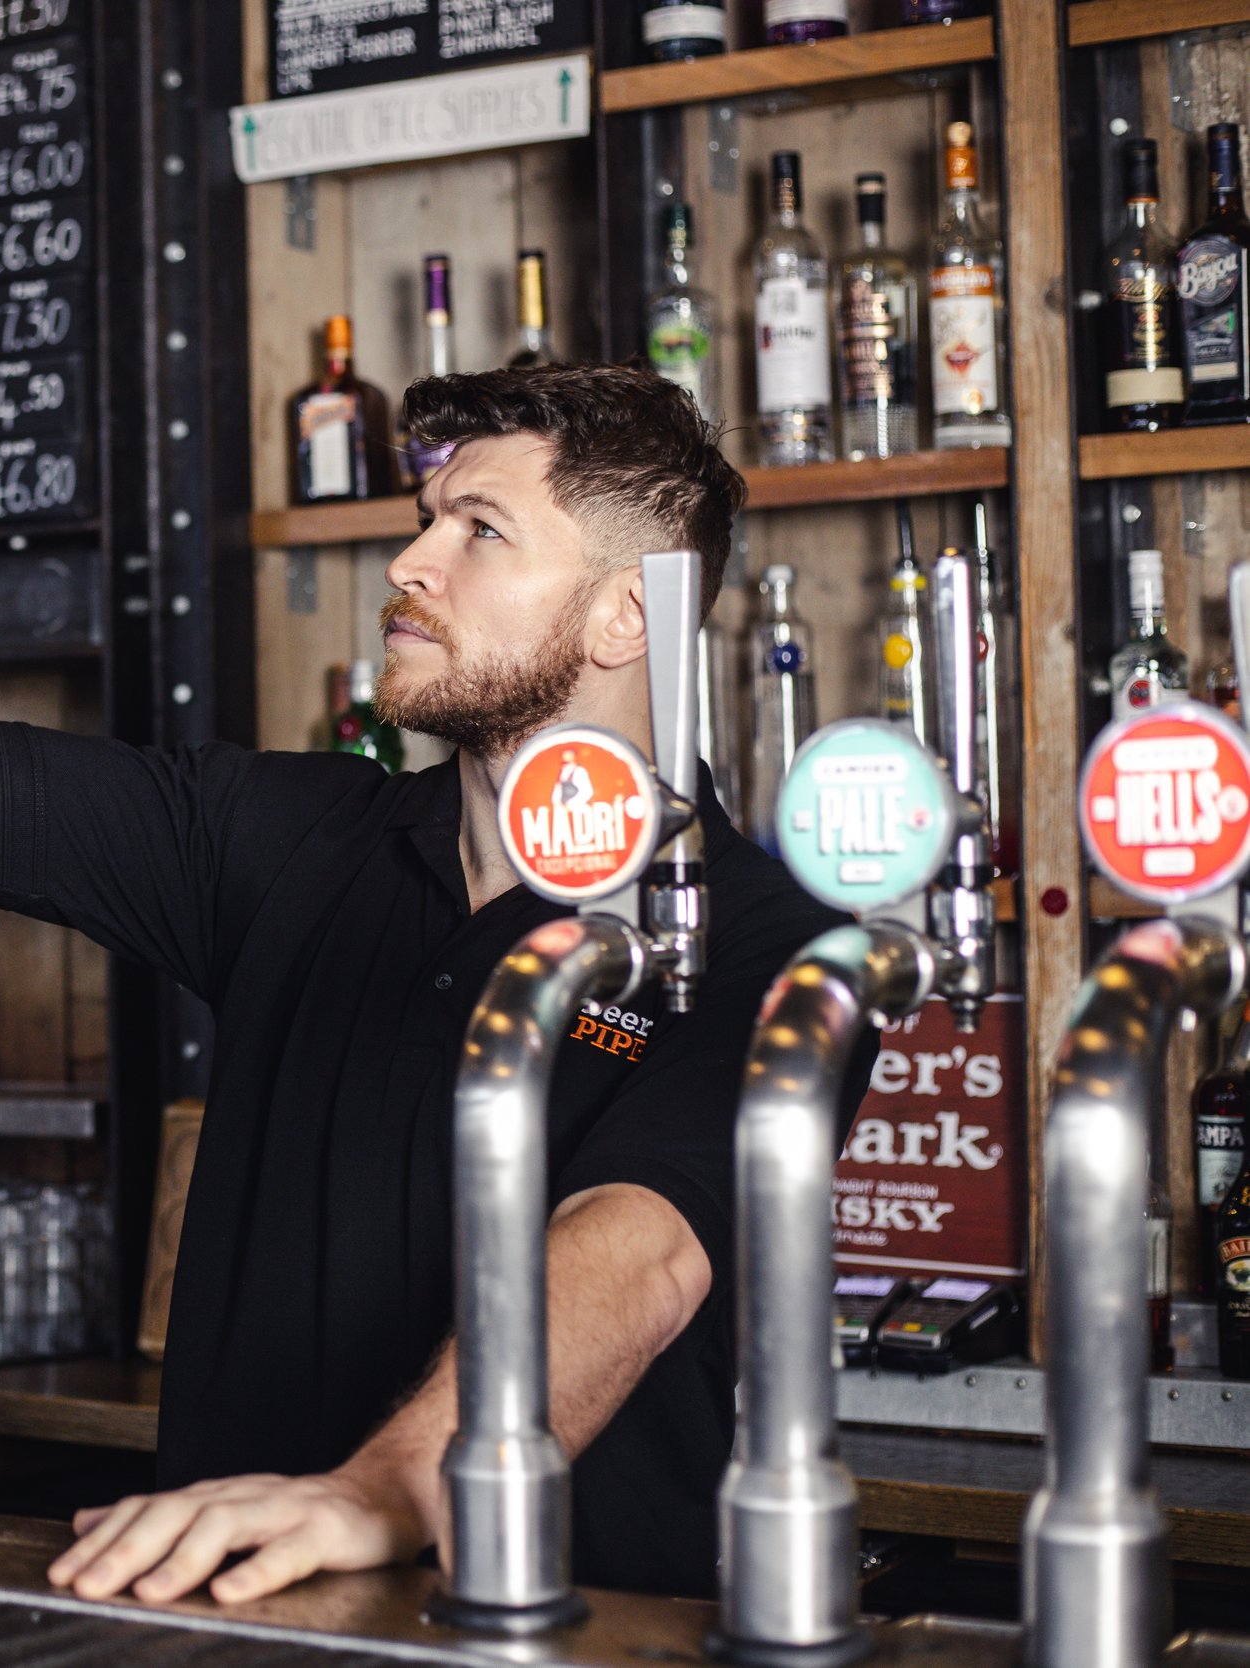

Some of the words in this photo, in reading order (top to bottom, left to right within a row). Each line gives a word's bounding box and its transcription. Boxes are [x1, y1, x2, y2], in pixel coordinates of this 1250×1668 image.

[818, 785, 905, 856] PALE
[1116, 770, 1222, 846] HELLS
[870, 1045, 1003, 1098] er's
[840, 1111, 998, 1170] ark
[1196, 1125, 1245, 1147] AMPA
